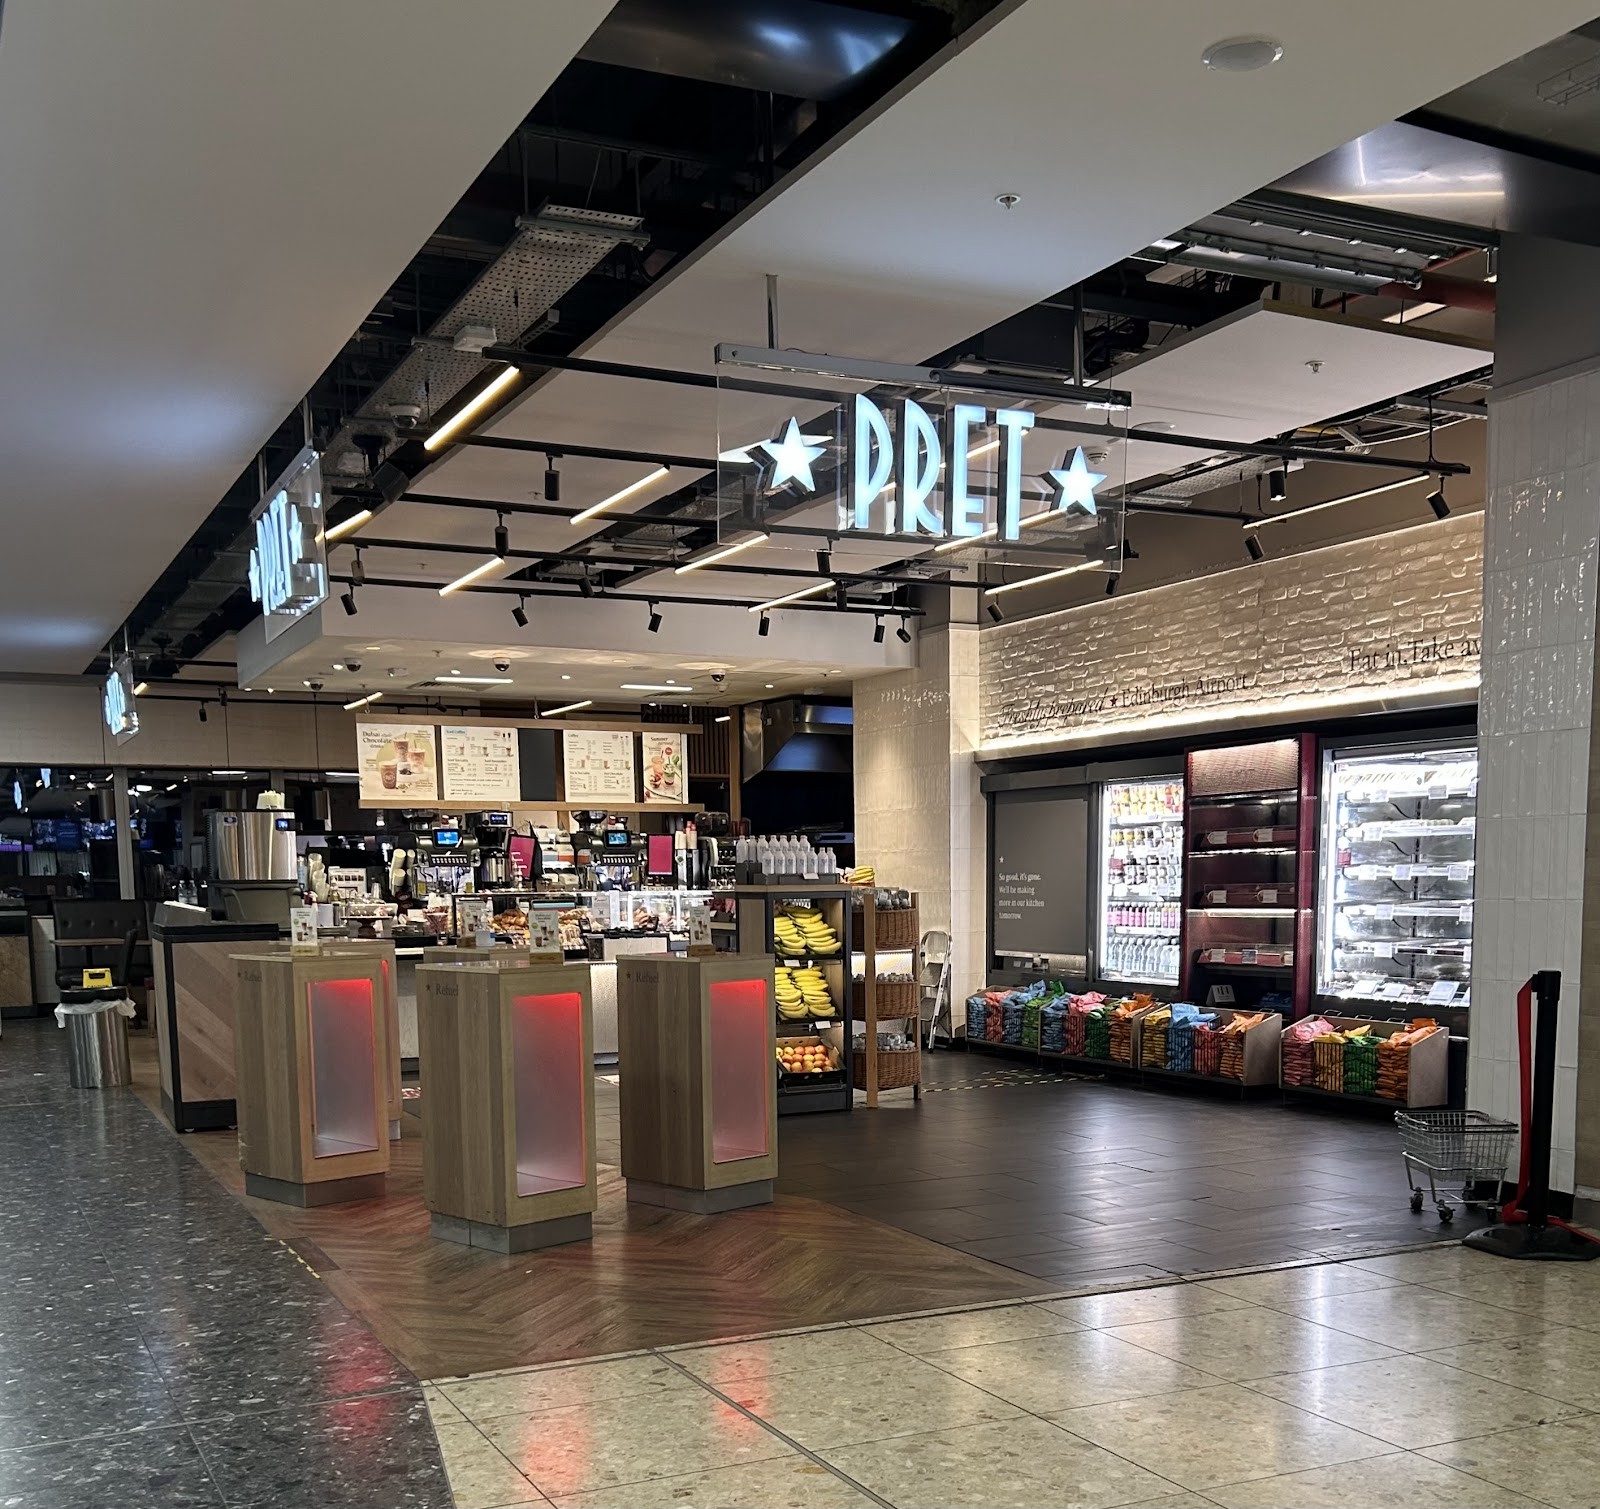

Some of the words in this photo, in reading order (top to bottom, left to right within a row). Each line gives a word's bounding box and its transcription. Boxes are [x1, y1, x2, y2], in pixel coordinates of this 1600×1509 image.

[854, 393, 1035, 541] PRET
[1350, 648, 1380, 672] Eat
[1408, 636, 1454, 664] Take
[1121, 678, 1190, 708] Edinburgh
[1195, 673, 1248, 699] Airport
[999, 872, 1006, 882] So
[1017, 886, 1035, 896] making
[1026, 898, 1045, 907] kitchen
